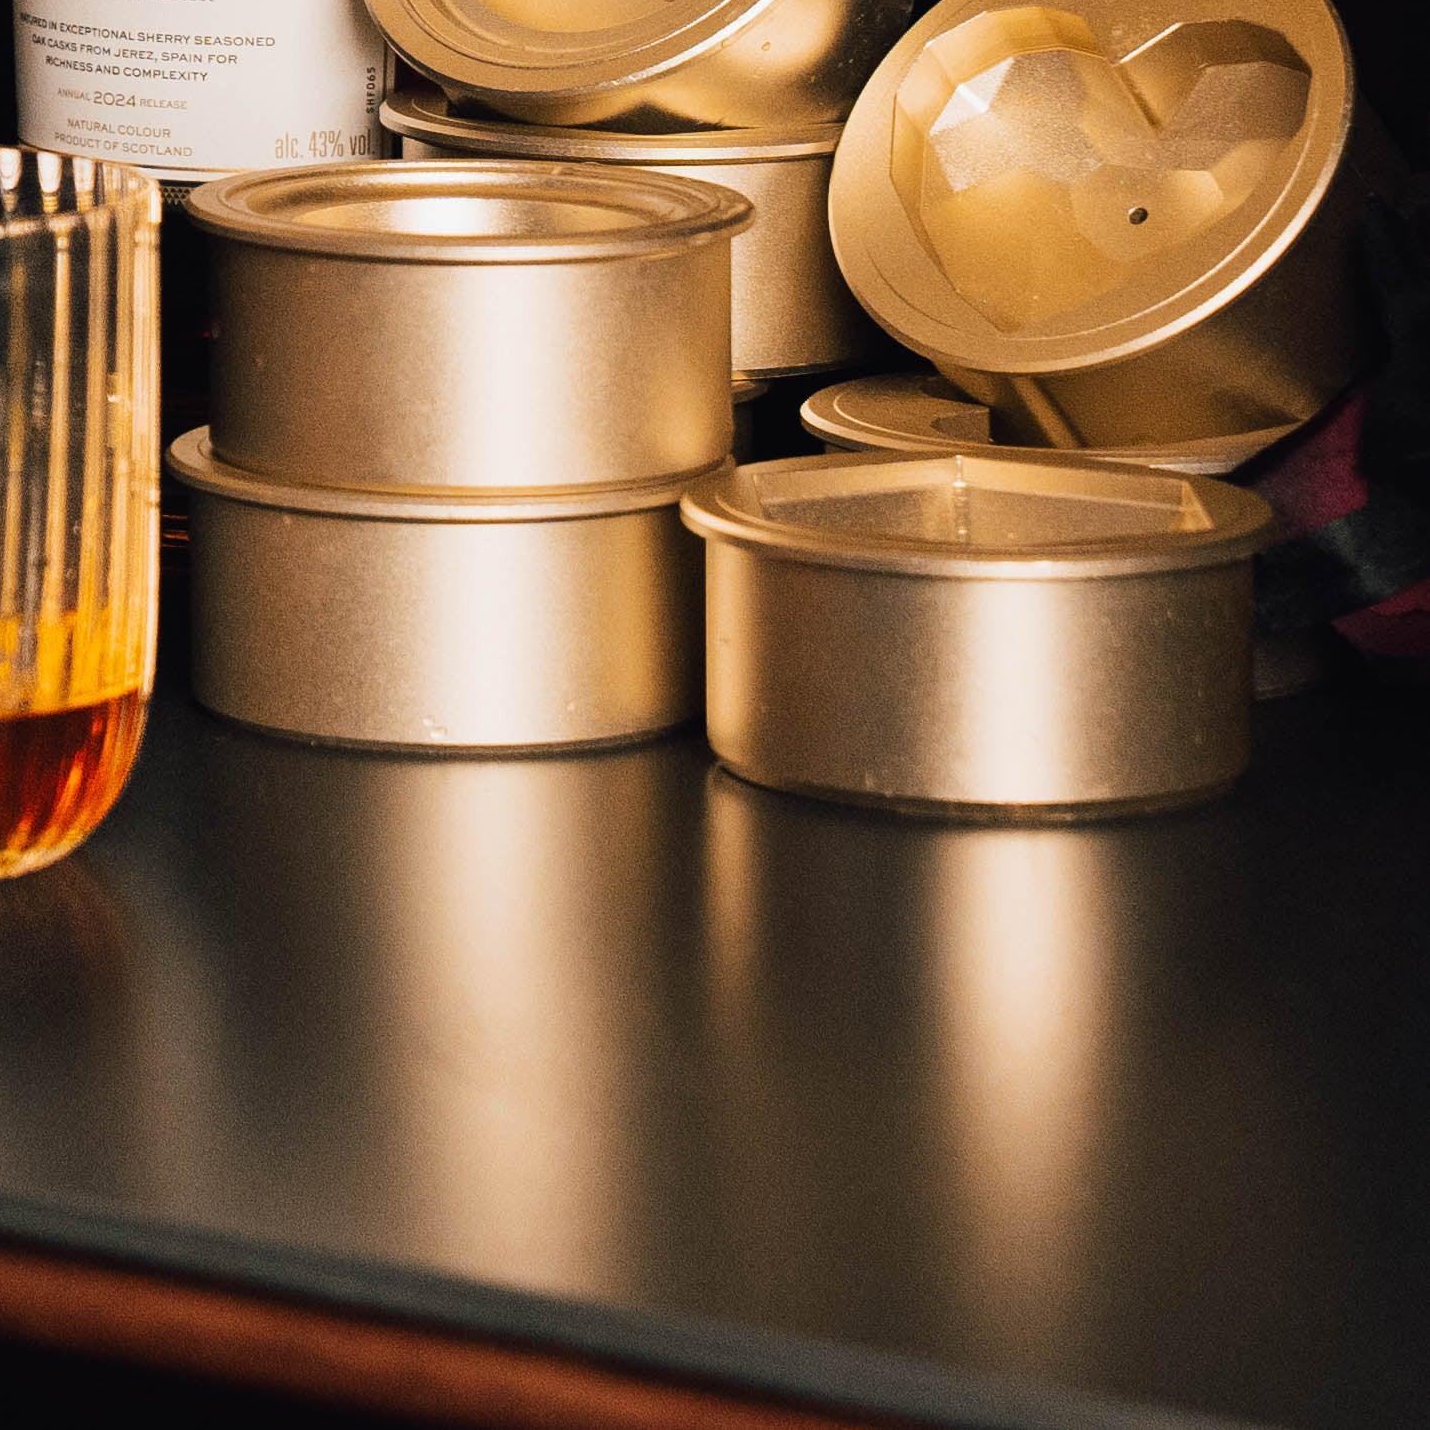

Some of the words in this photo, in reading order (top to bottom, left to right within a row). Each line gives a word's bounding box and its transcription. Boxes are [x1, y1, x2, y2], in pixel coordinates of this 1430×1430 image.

[48, 19, 57, 31] IN
[59, 22, 136, 42] EXCEPTIONAL
[137, 32, 190, 45] SHERRY
[194, 35, 276, 48] SEASONED
[47, 38, 77, 53] CASKS
[79, 43, 111, 57] FROM
[113, 48, 158, 63] JEREZ,
[161, 52, 203, 64] SPAIN
[207, 54, 238, 65] FOR
[45, 55, 93, 74] RICHNESS
[95, 65, 120, 76] AND
[123, 66, 208, 82] COMPLEXITY
[58, 87, 91, 101] ANNUAL
[93, 90, 136, 108] 2024
[140, 98, 188, 110] RELEASE
[67, 118, 115, 135] NATURAL
[117, 124, 171, 138] COLOUR
[54, 131, 101, 149] PRODUCT
[104, 140, 119, 151] OF
[122, 142, 194, 157] SCOTLAND
[274, 132, 304, 159] alc.
[308, 130, 344, 158] 43%
[349, 129, 376, 156] vol.
